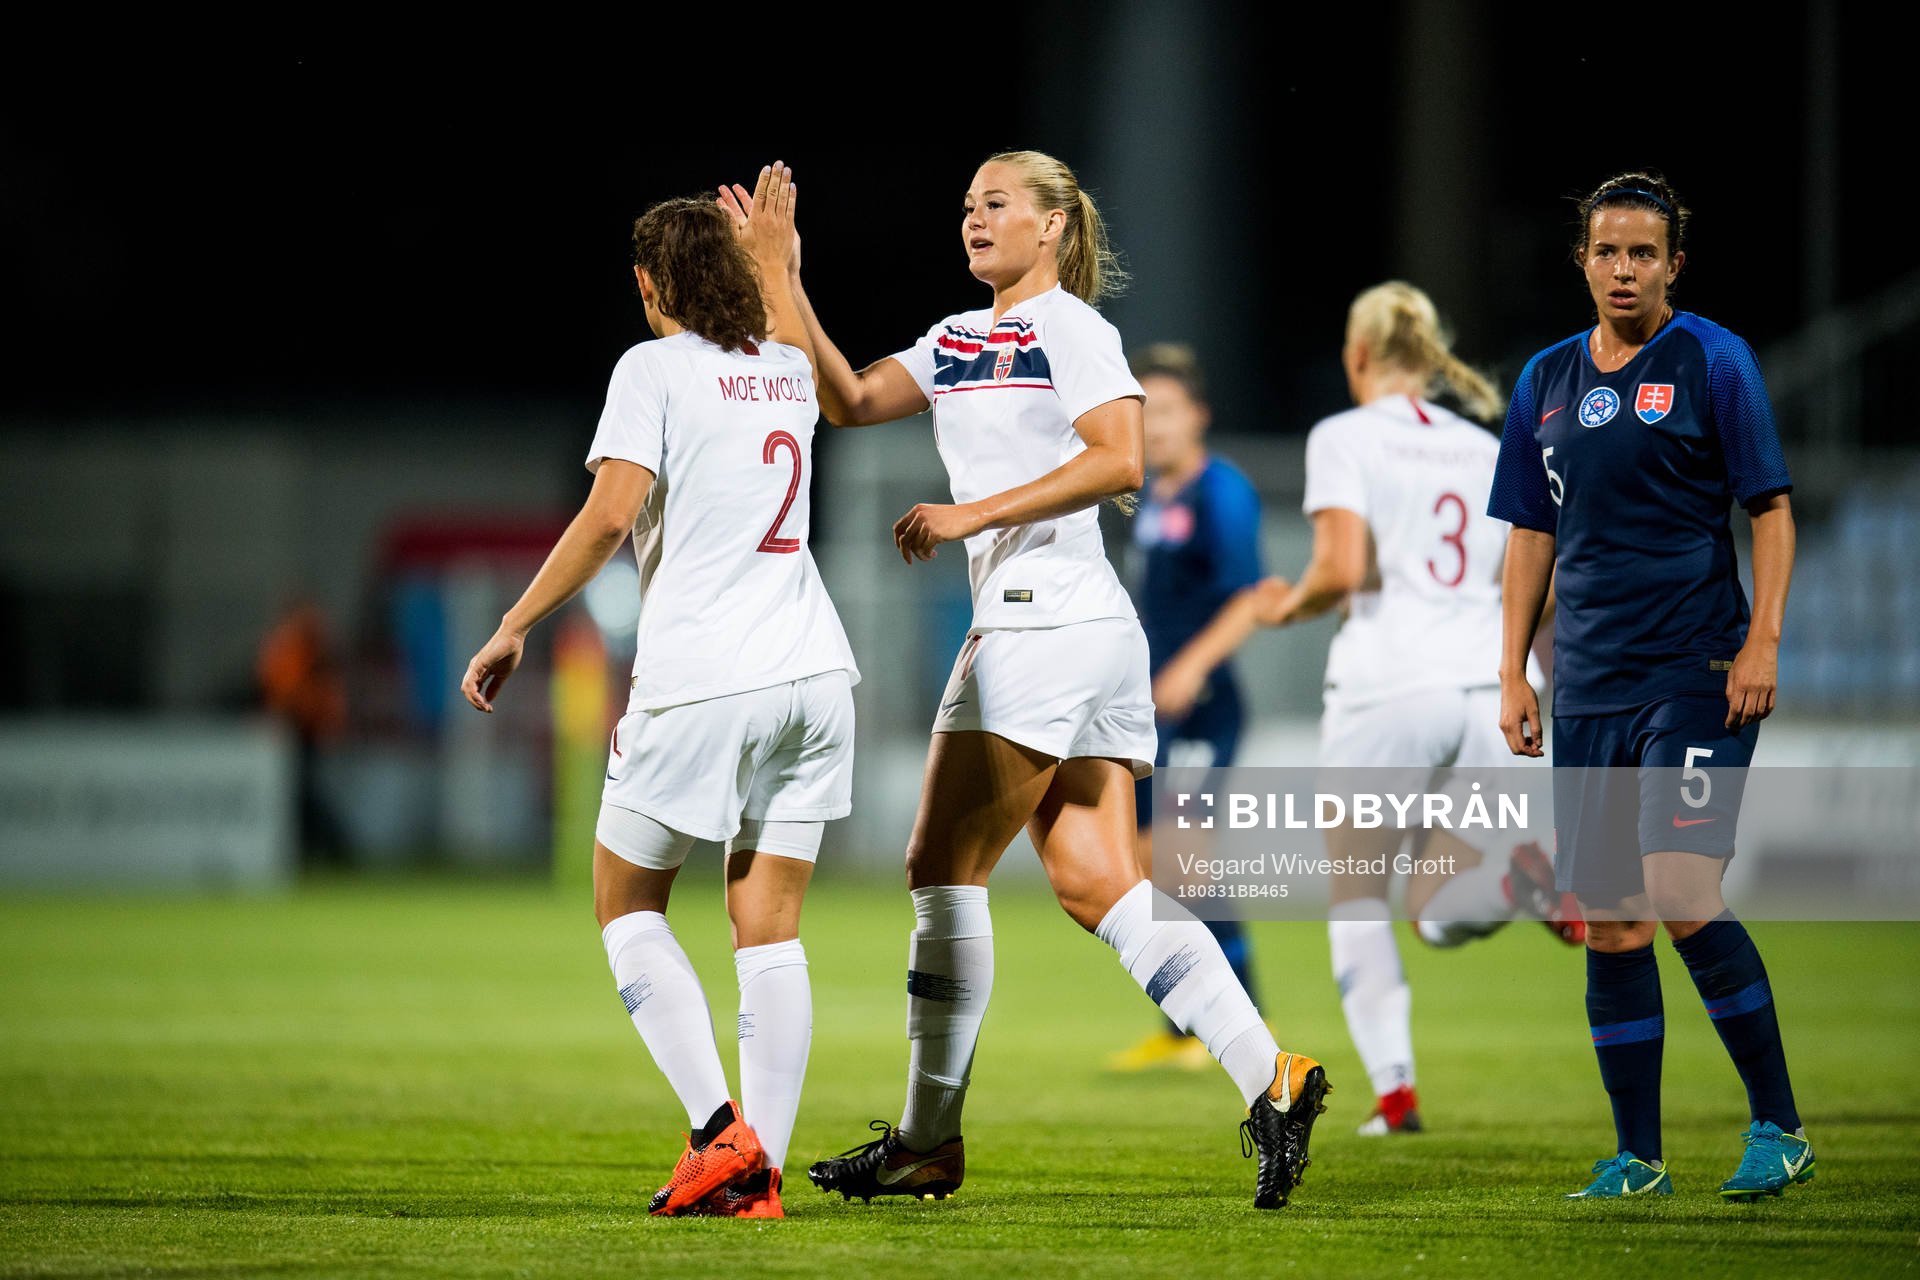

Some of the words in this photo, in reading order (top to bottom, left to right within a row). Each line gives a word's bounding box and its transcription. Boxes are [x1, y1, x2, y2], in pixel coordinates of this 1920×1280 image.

[718, 375, 759, 401] MOE
[762, 376, 807, 402] WOLD
[755, 430, 802, 554] 2
[1542, 446, 1564, 507] 5
[1428, 492, 1468, 588] 3
[1680, 747, 1713, 808] 5
